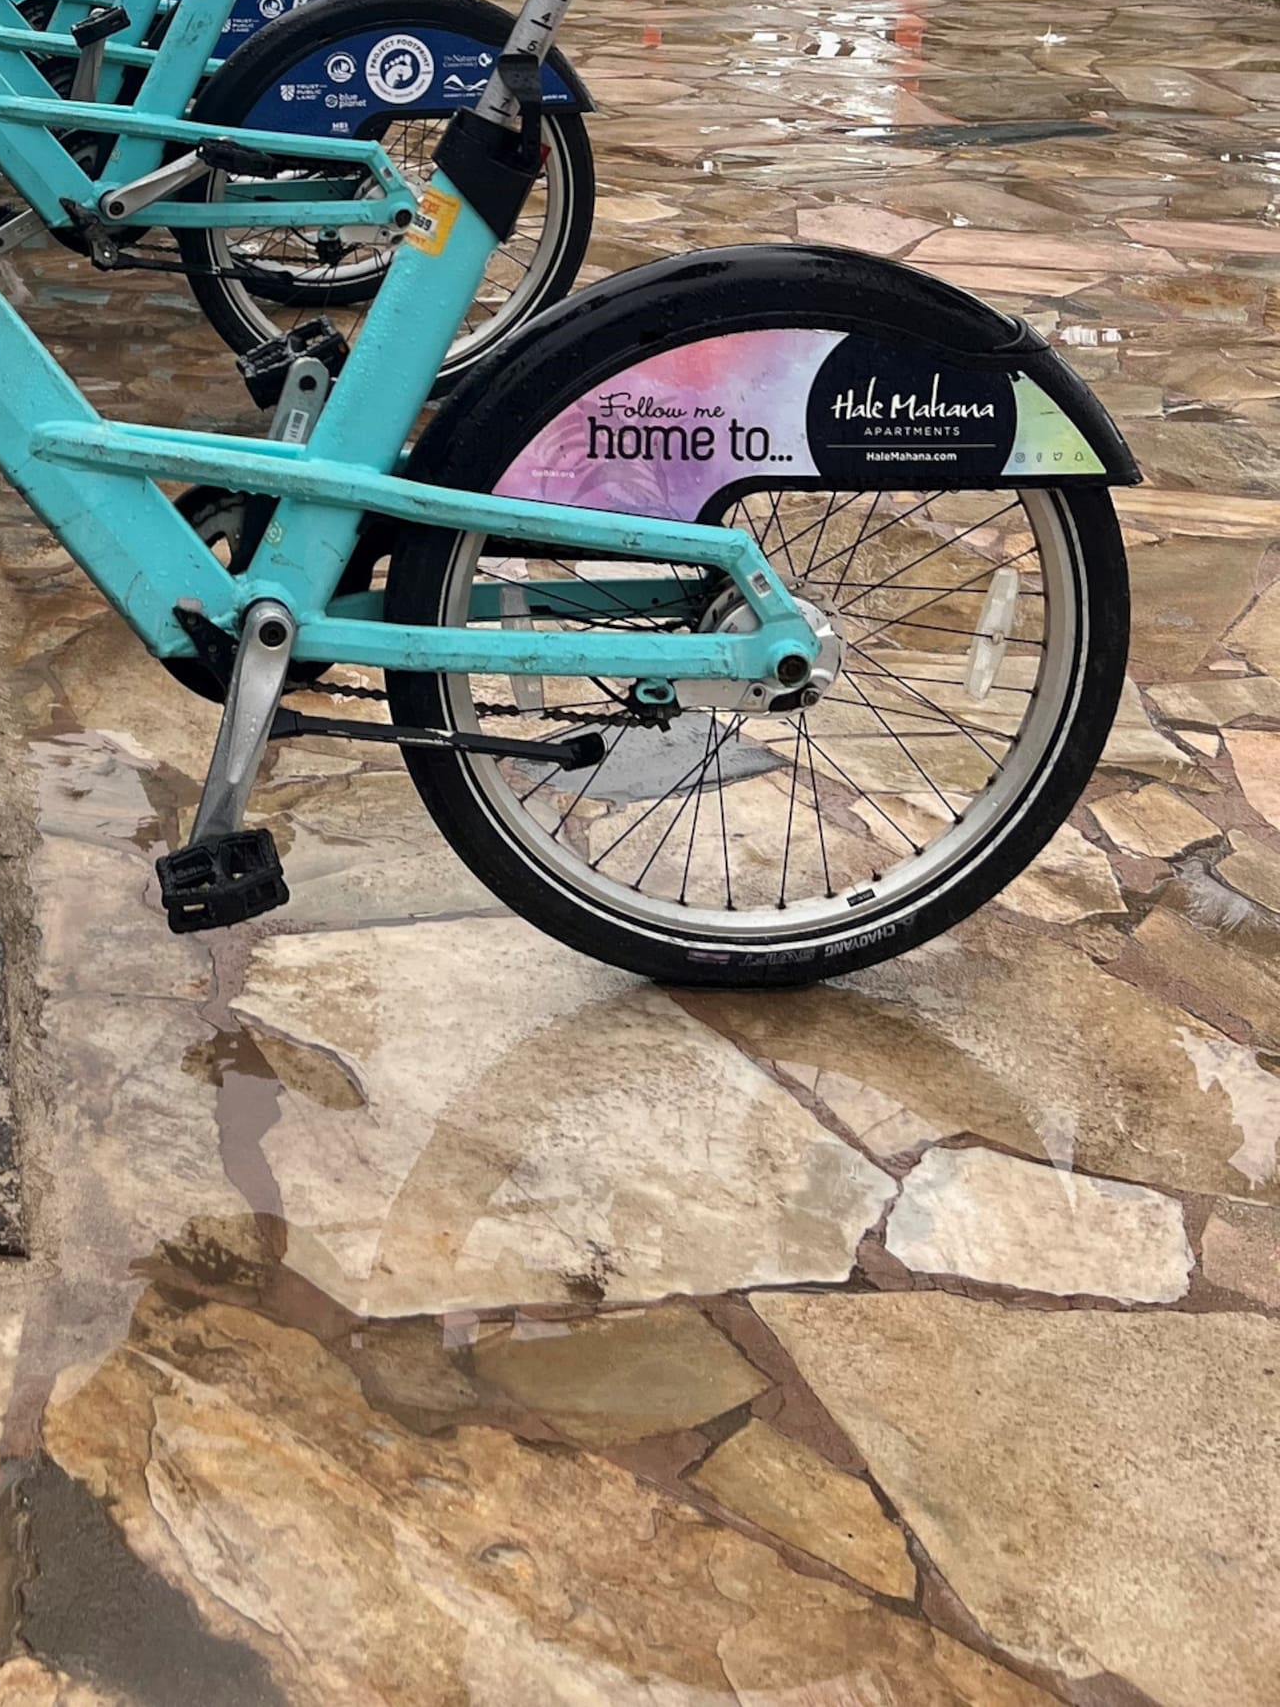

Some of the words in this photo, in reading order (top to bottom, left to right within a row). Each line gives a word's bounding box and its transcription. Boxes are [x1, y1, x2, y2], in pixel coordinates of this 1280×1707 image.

[541, 13, 552, 23] 4
[371, 40, 394, 69] PROJECT
[397, 39, 430, 68] FOOTPRINT
[339, 93, 358, 101] blue
[339, 99, 366, 109] planet
[500, 98, 511, 108] 7
[830, 376, 884, 420] Hale
[890, 373, 995, 420] Mahana
[599, 392, 687, 419] Follow
[693, 405, 725, 419] me
[864, 426, 961, 436] APARTMENTS
[586, 416, 715, 461] home
[729, 418, 793, 461] to...
[866, 452, 957, 462] HaleMahana.com
[824, 923, 896, 957] CHAOYANG
